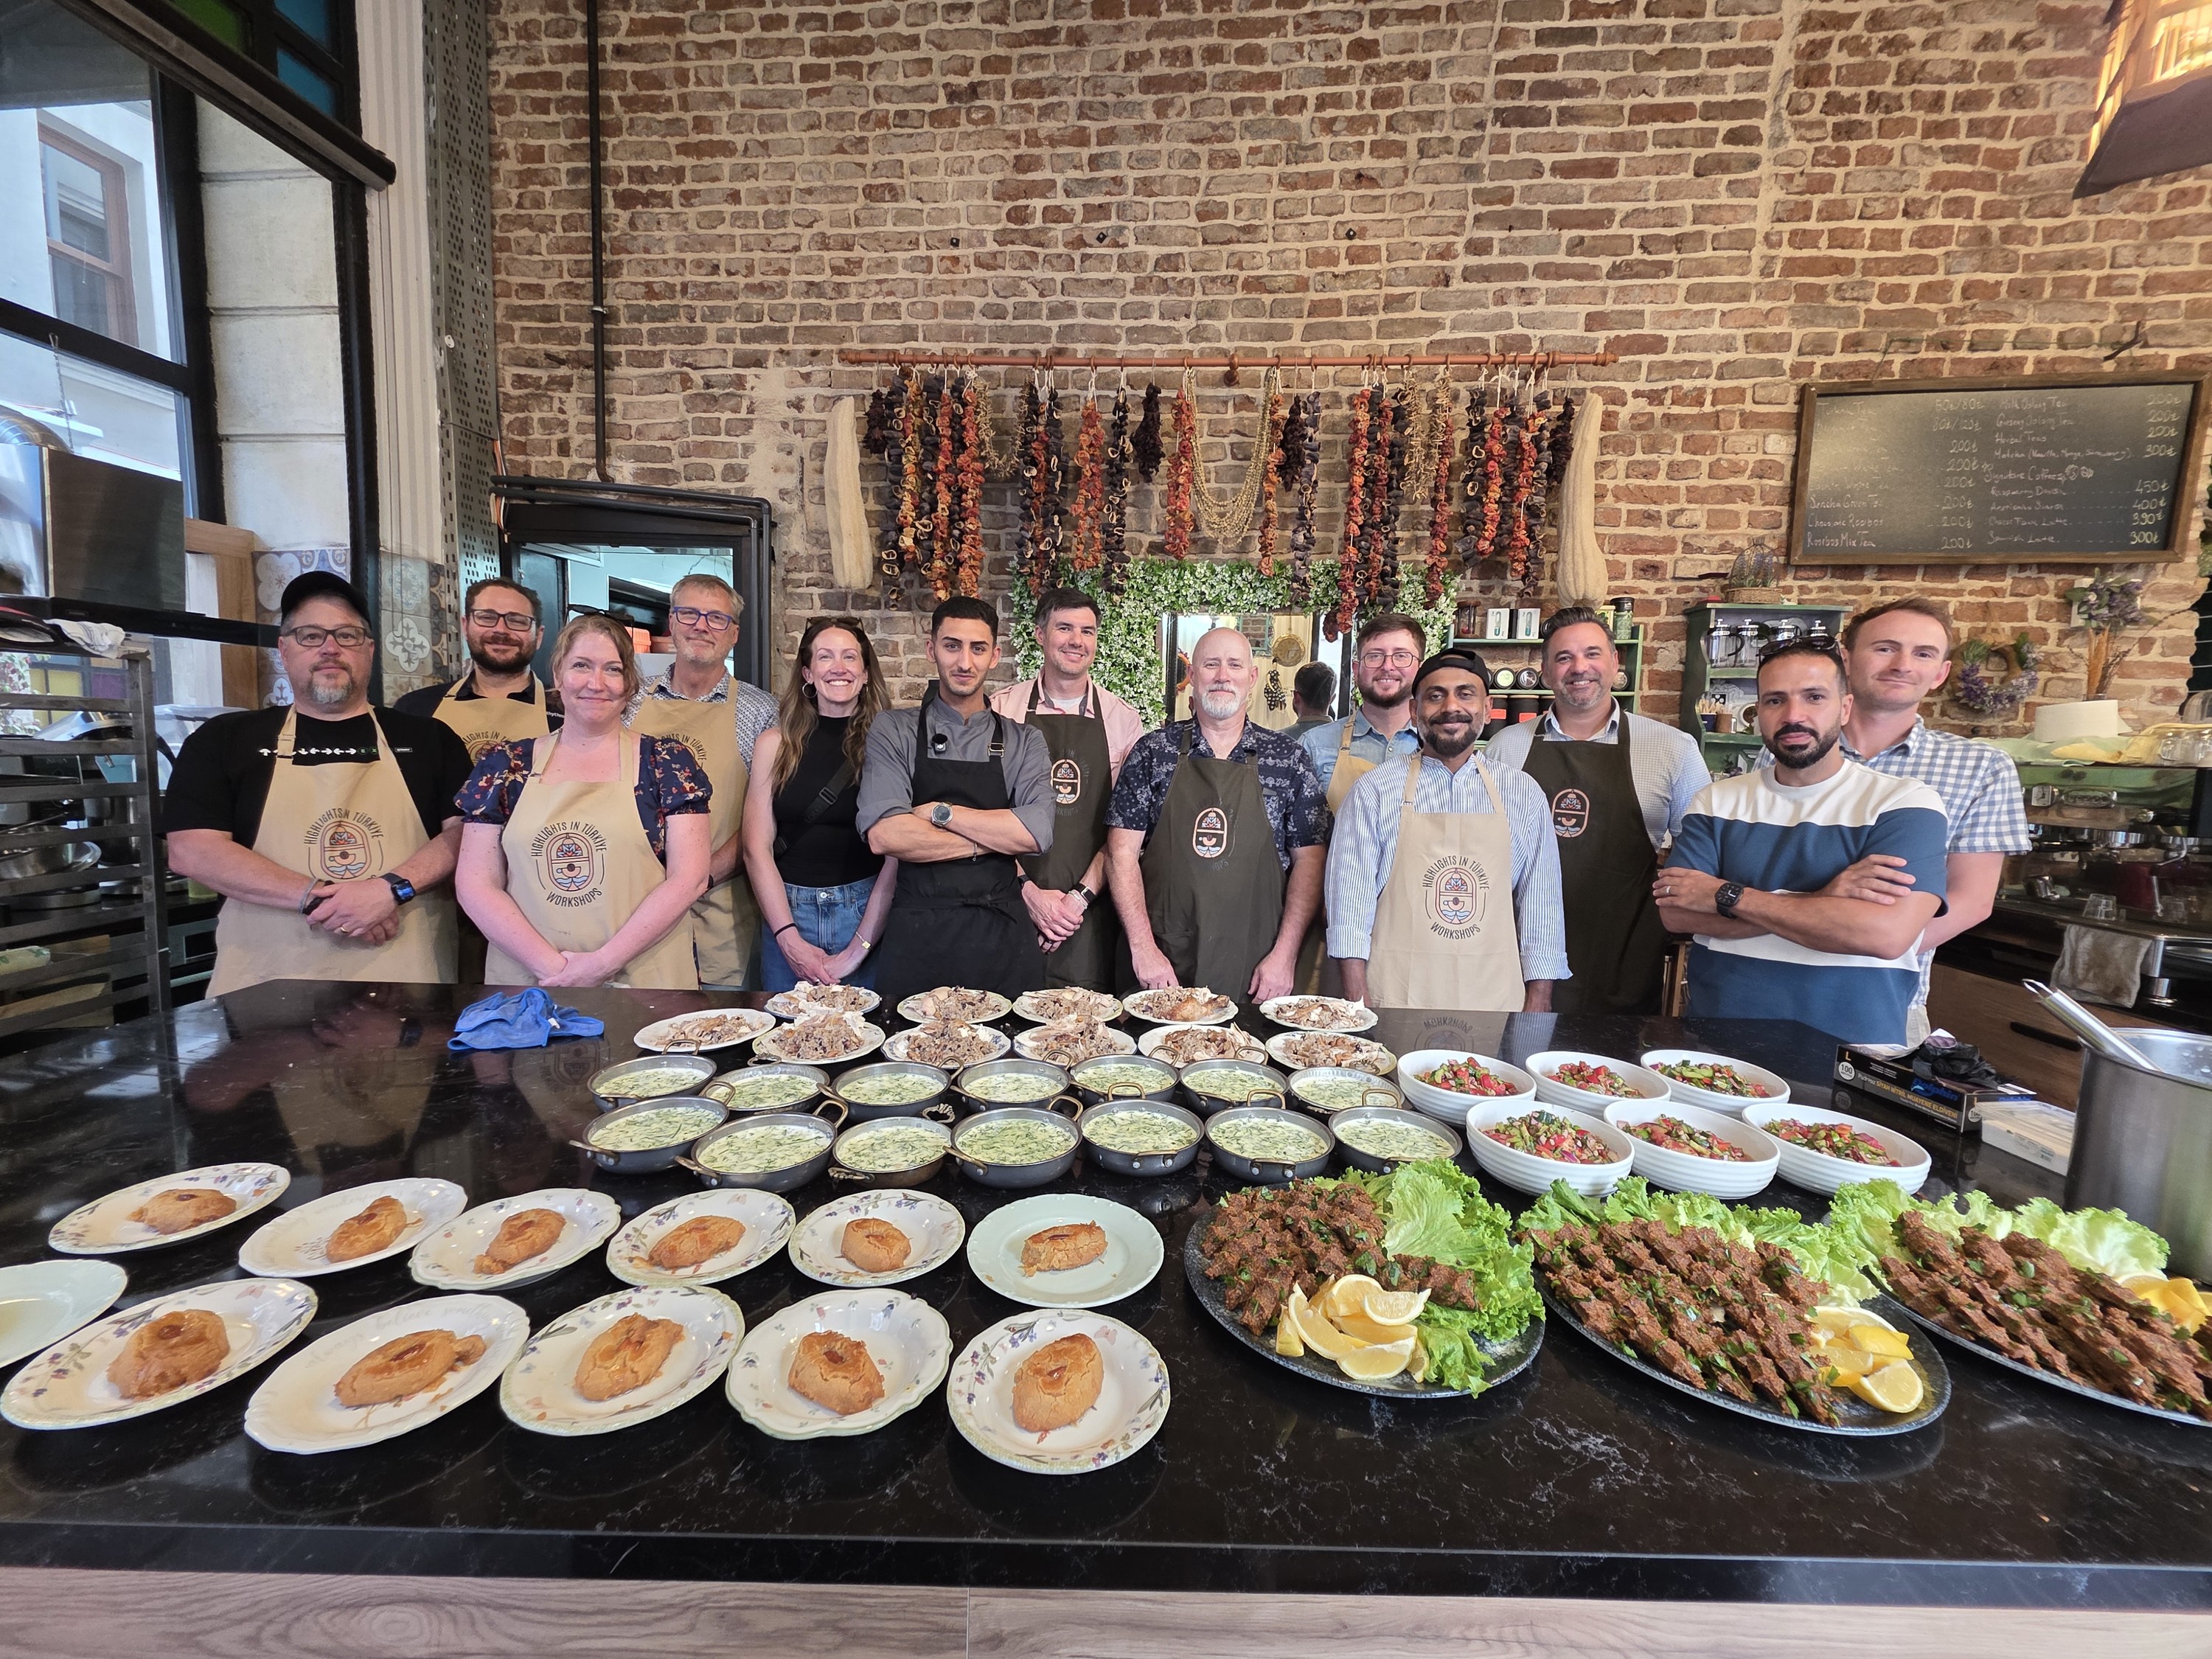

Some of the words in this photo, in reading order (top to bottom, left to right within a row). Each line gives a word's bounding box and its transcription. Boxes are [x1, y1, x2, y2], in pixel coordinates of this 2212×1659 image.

[2045, 396, 2069, 408] Tea
[2056, 411, 2076, 426] Tea
[1843, 493, 1868, 509] Green
[1840, 531, 1857, 547] Mix
[1857, 530, 1877, 548] Tea
[490, 730, 500, 740] IN
[681, 734, 691, 744] IN
[303, 807, 343, 844] HIGHLIGHTS
[530, 821, 567, 857] HIGHLIGHTS
[570, 821, 580, 831] IN
[581, 823, 607, 852] TÜRKİYE
[1422, 855, 1457, 888] HIGHLIGHTS
[1458, 855, 1469, 867] IN
[1469, 860, 1489, 890] TÜRKİYE
[546, 887, 602, 908] WORKSHOPS
[1430, 921, 1481, 940] WORKSHOPS
[1845, 1051, 1851, 1061] L
[1841, 1064, 1853, 1074] 100
